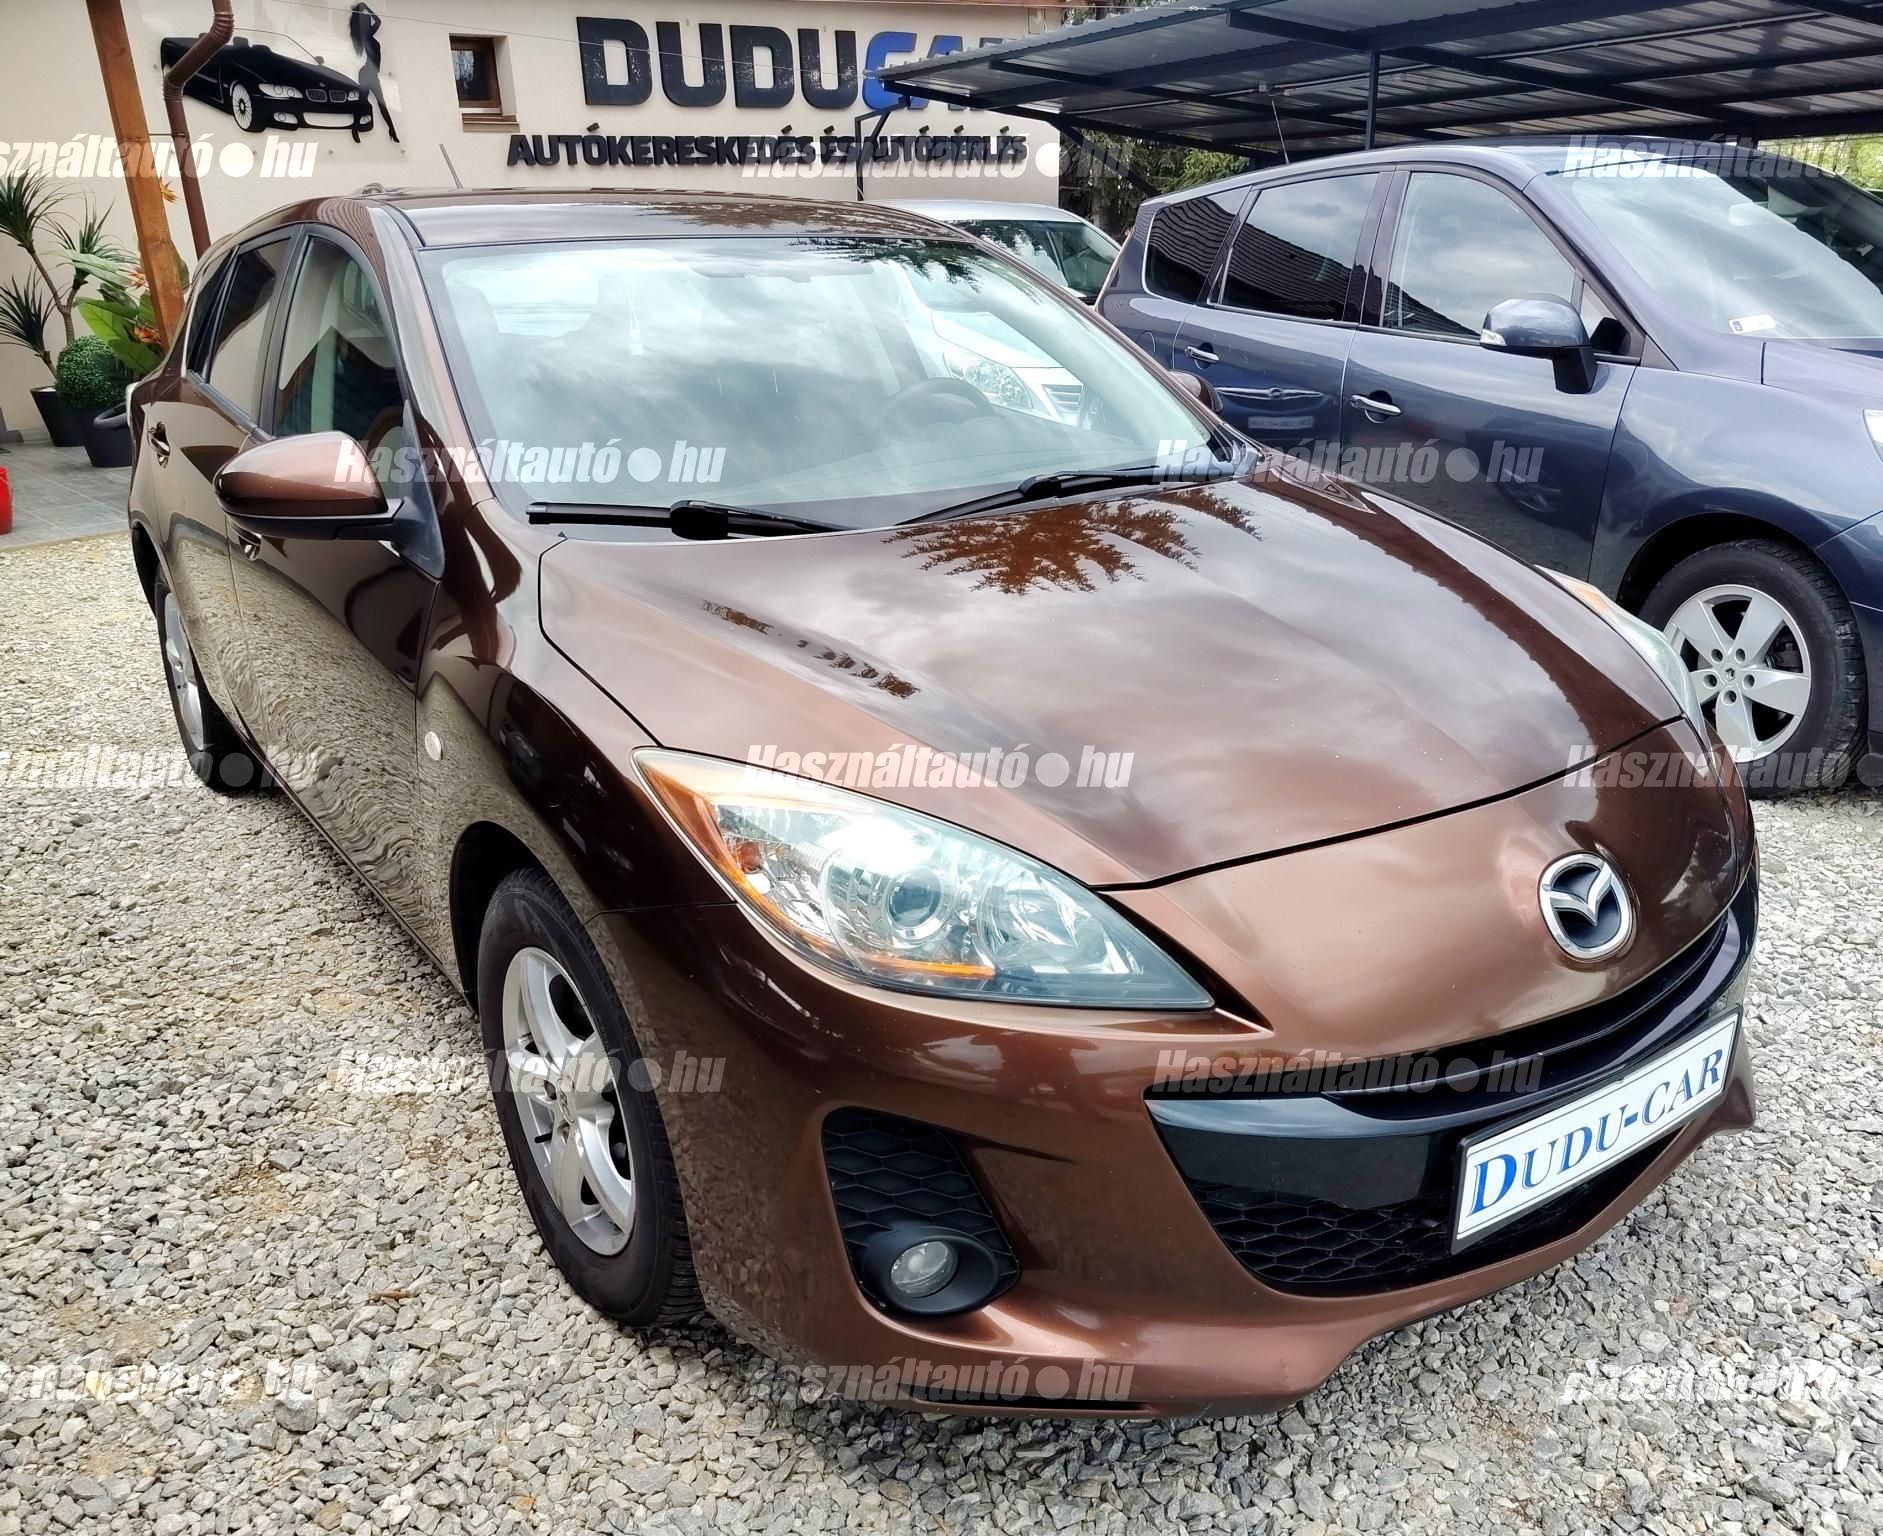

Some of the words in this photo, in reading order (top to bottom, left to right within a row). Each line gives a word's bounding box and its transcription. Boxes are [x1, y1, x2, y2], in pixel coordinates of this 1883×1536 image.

[576, 16, 1018, 110] DUDUC
[507, 123, 816, 166] AUTÓKERESKEDÉS
[820, 125, 857, 165] ÉS
[1466, 1049, 1723, 1217] DUDU-CAR
